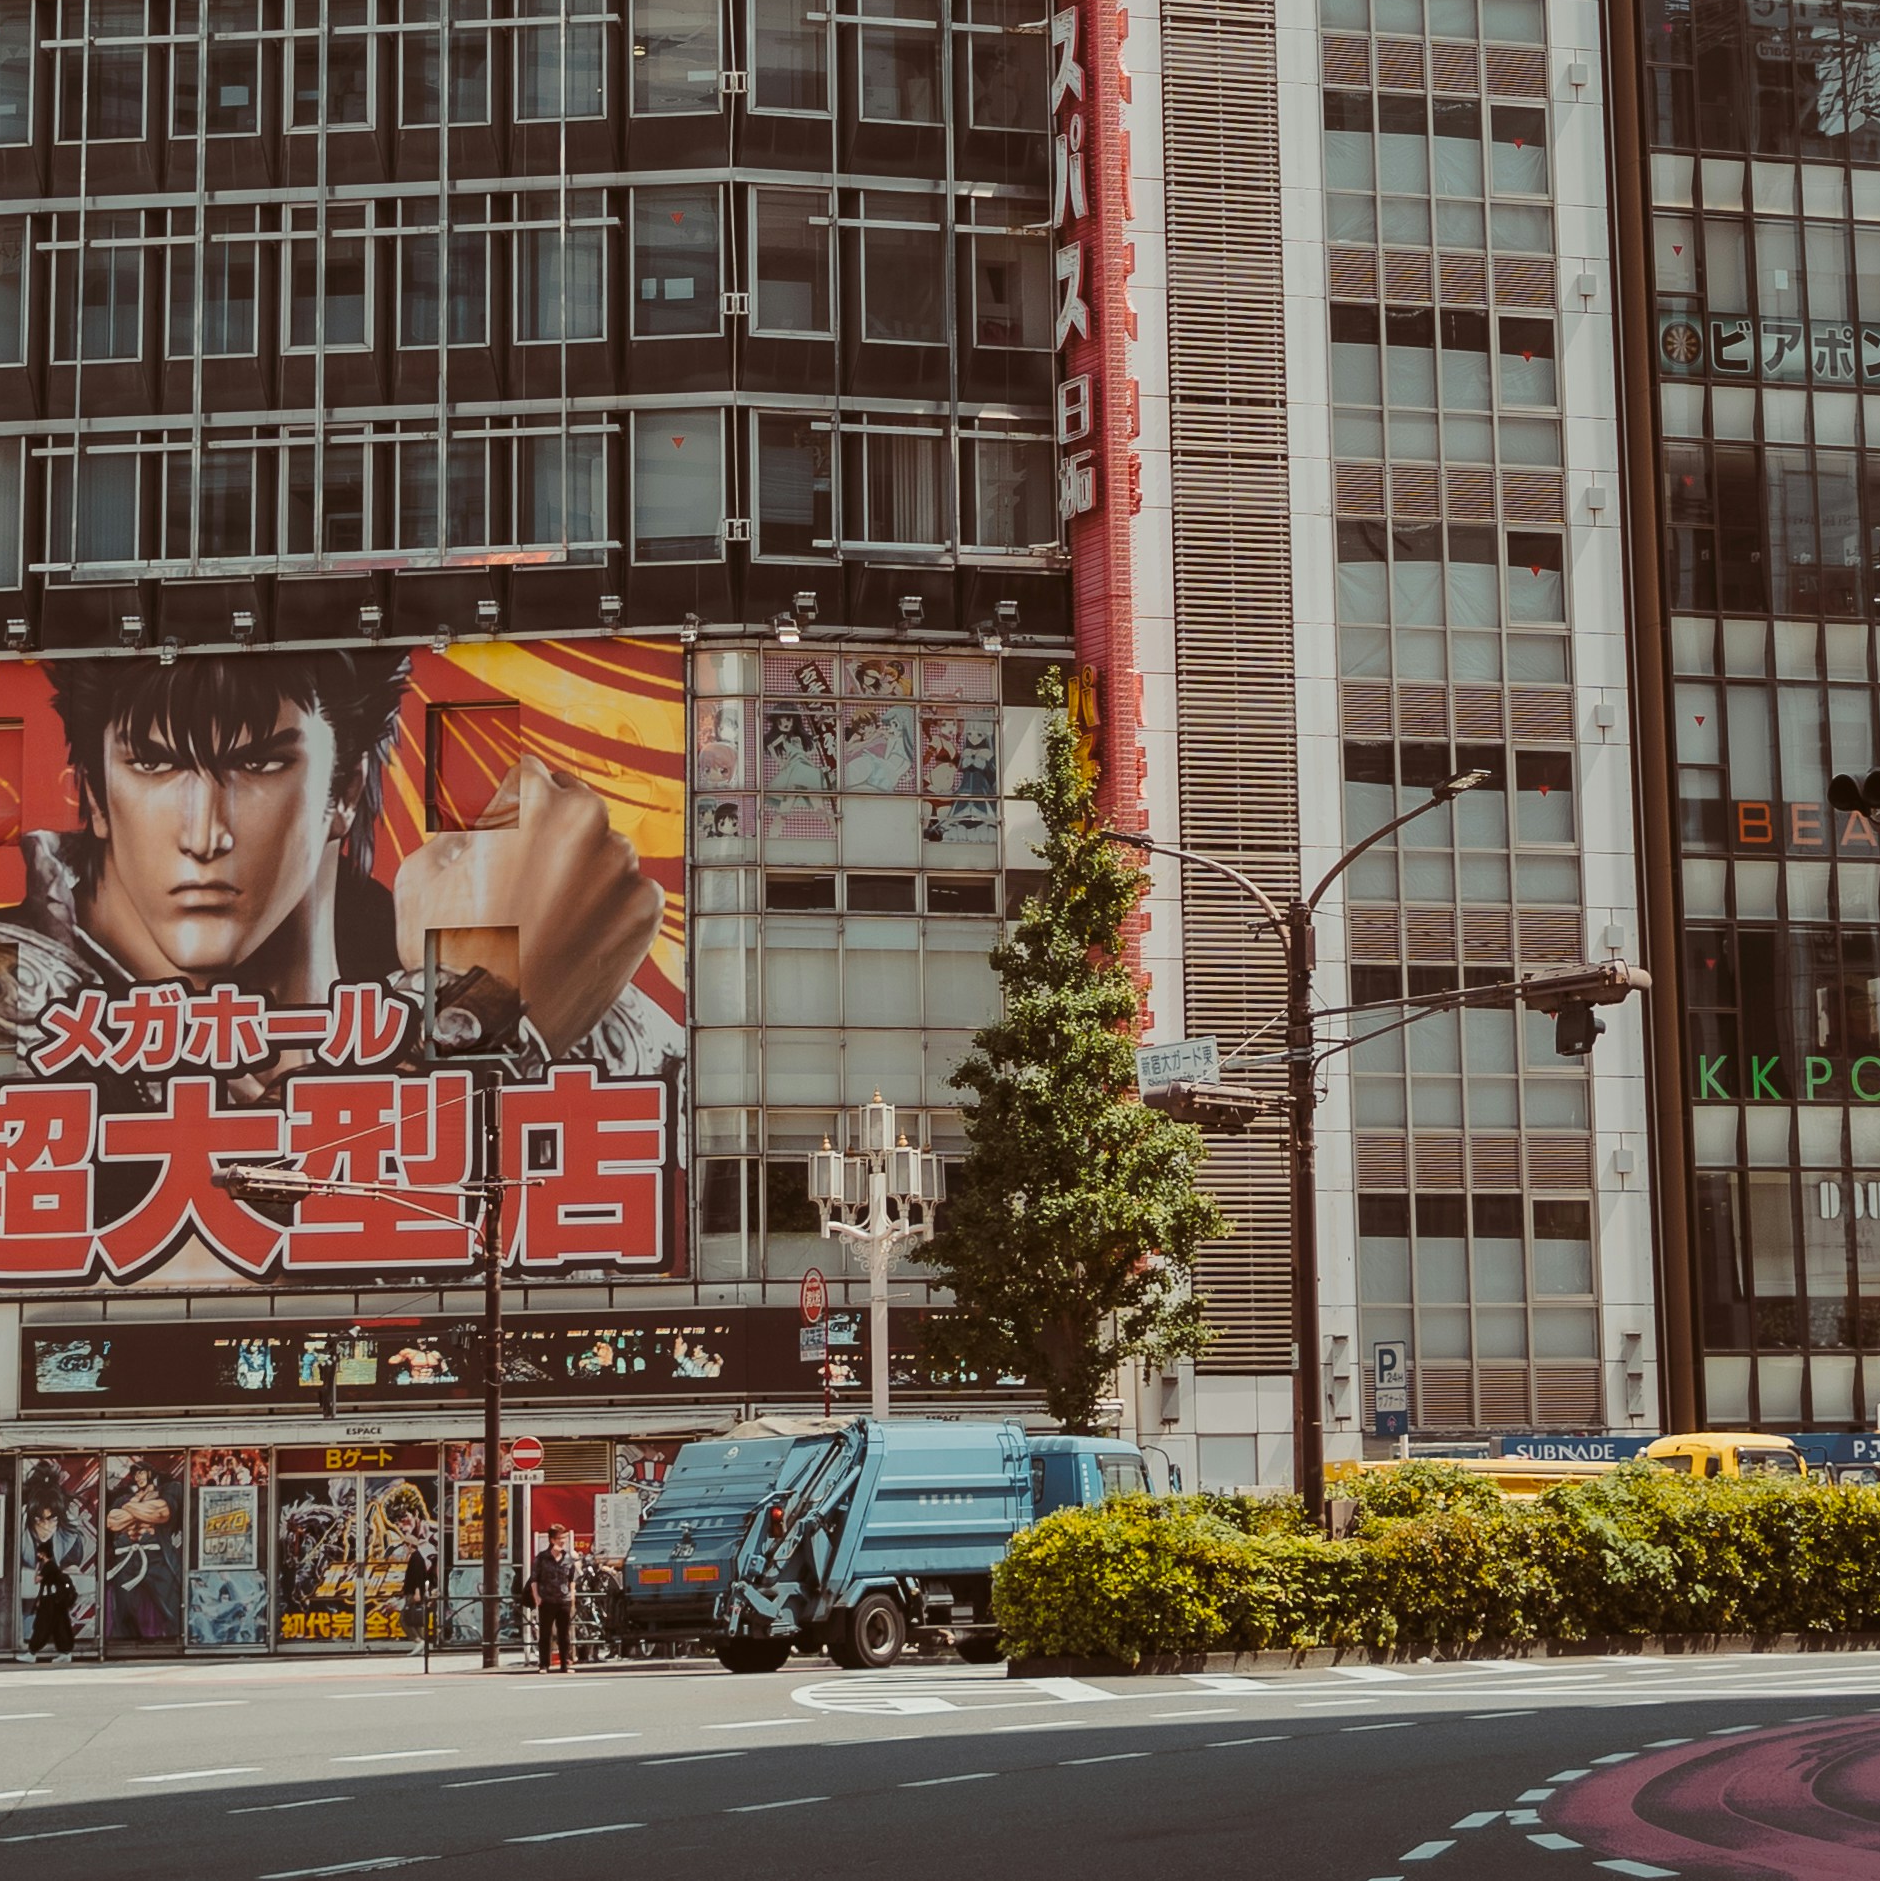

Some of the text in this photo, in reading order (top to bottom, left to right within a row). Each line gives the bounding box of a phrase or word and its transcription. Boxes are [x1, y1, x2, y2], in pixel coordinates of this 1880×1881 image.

[1057, 373, 1097, 521] 日拓
[29, 983, 409, 1074] メガホール
[1378, 1348, 1397, 1383] P
[1386, 1372, 1403, 1383] 24H
[346, 1427, 383, 1435] ESPACE
[326, 1449, 393, 1469] Bゲート
[1517, 1444, 1615, 1461] SUBNADE
